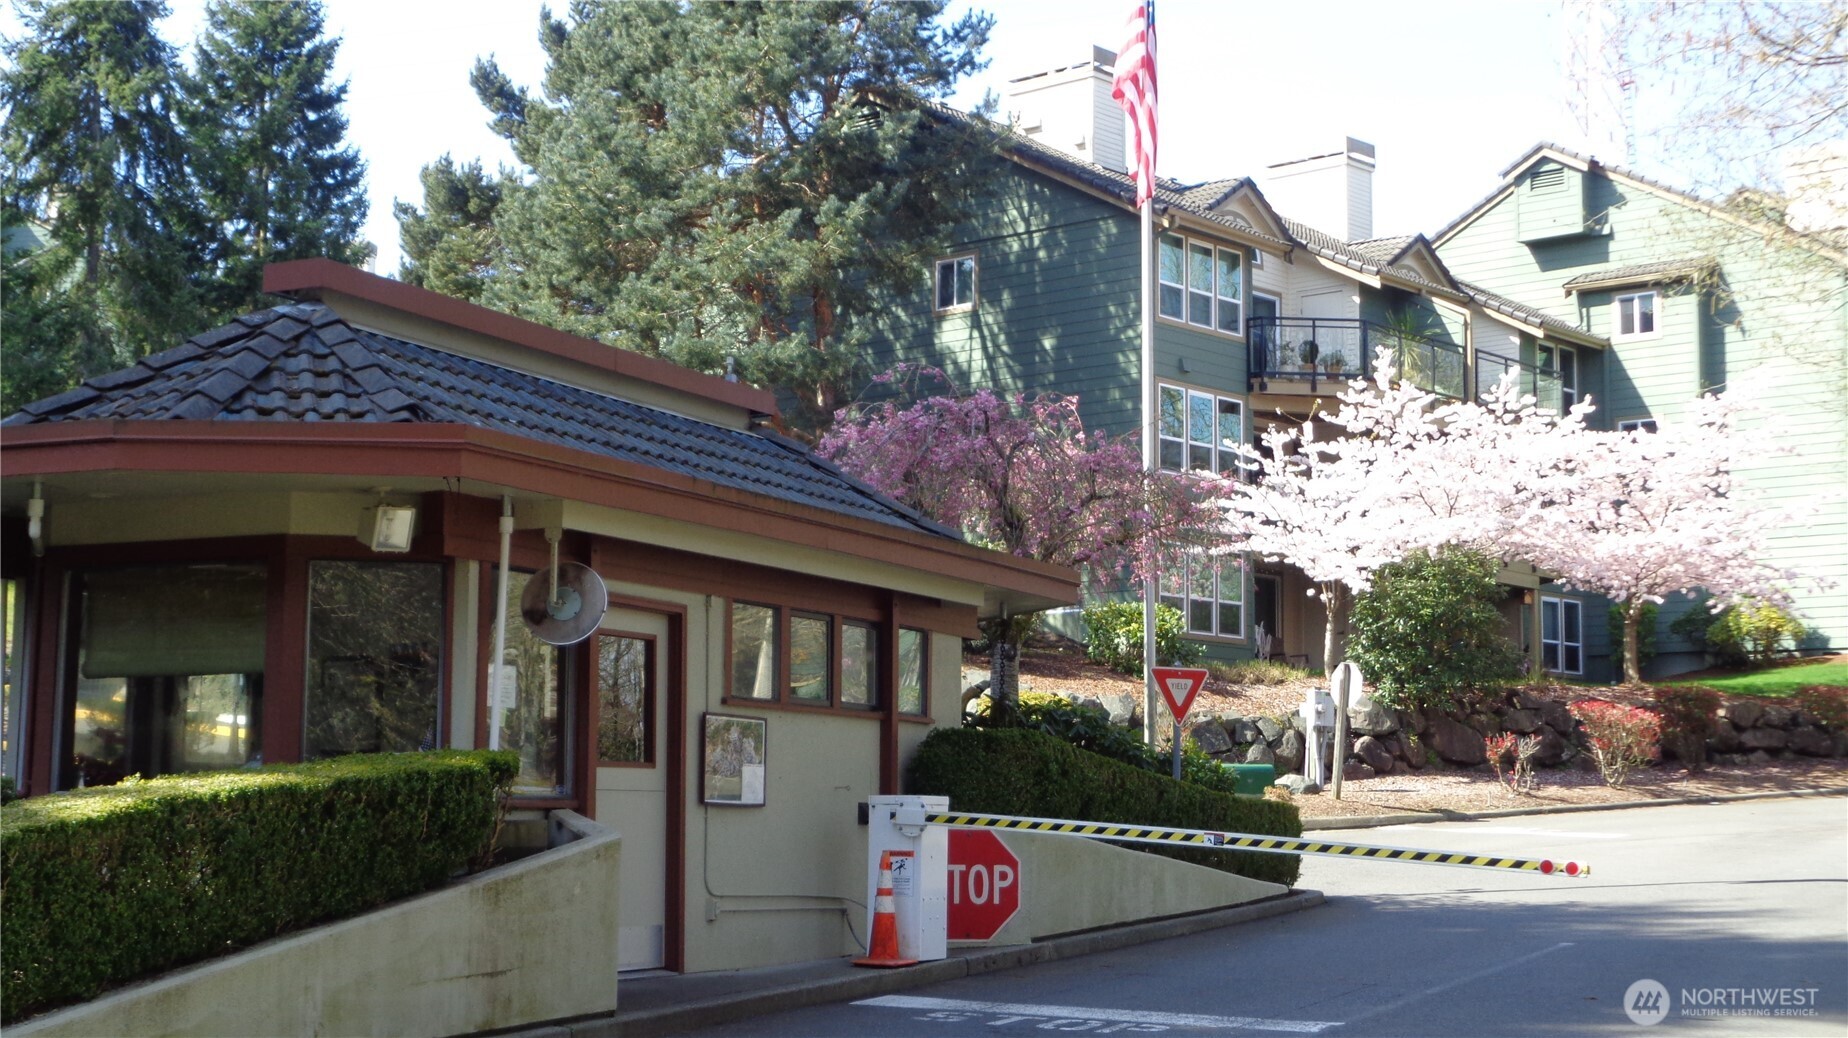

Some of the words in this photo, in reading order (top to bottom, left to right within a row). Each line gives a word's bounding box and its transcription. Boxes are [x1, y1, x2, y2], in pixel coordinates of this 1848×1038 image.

[1171, 682, 1188, 690] YIELD
[948, 864, 1014, 905] TOP
[913, 1011, 1170, 1033] STOP
